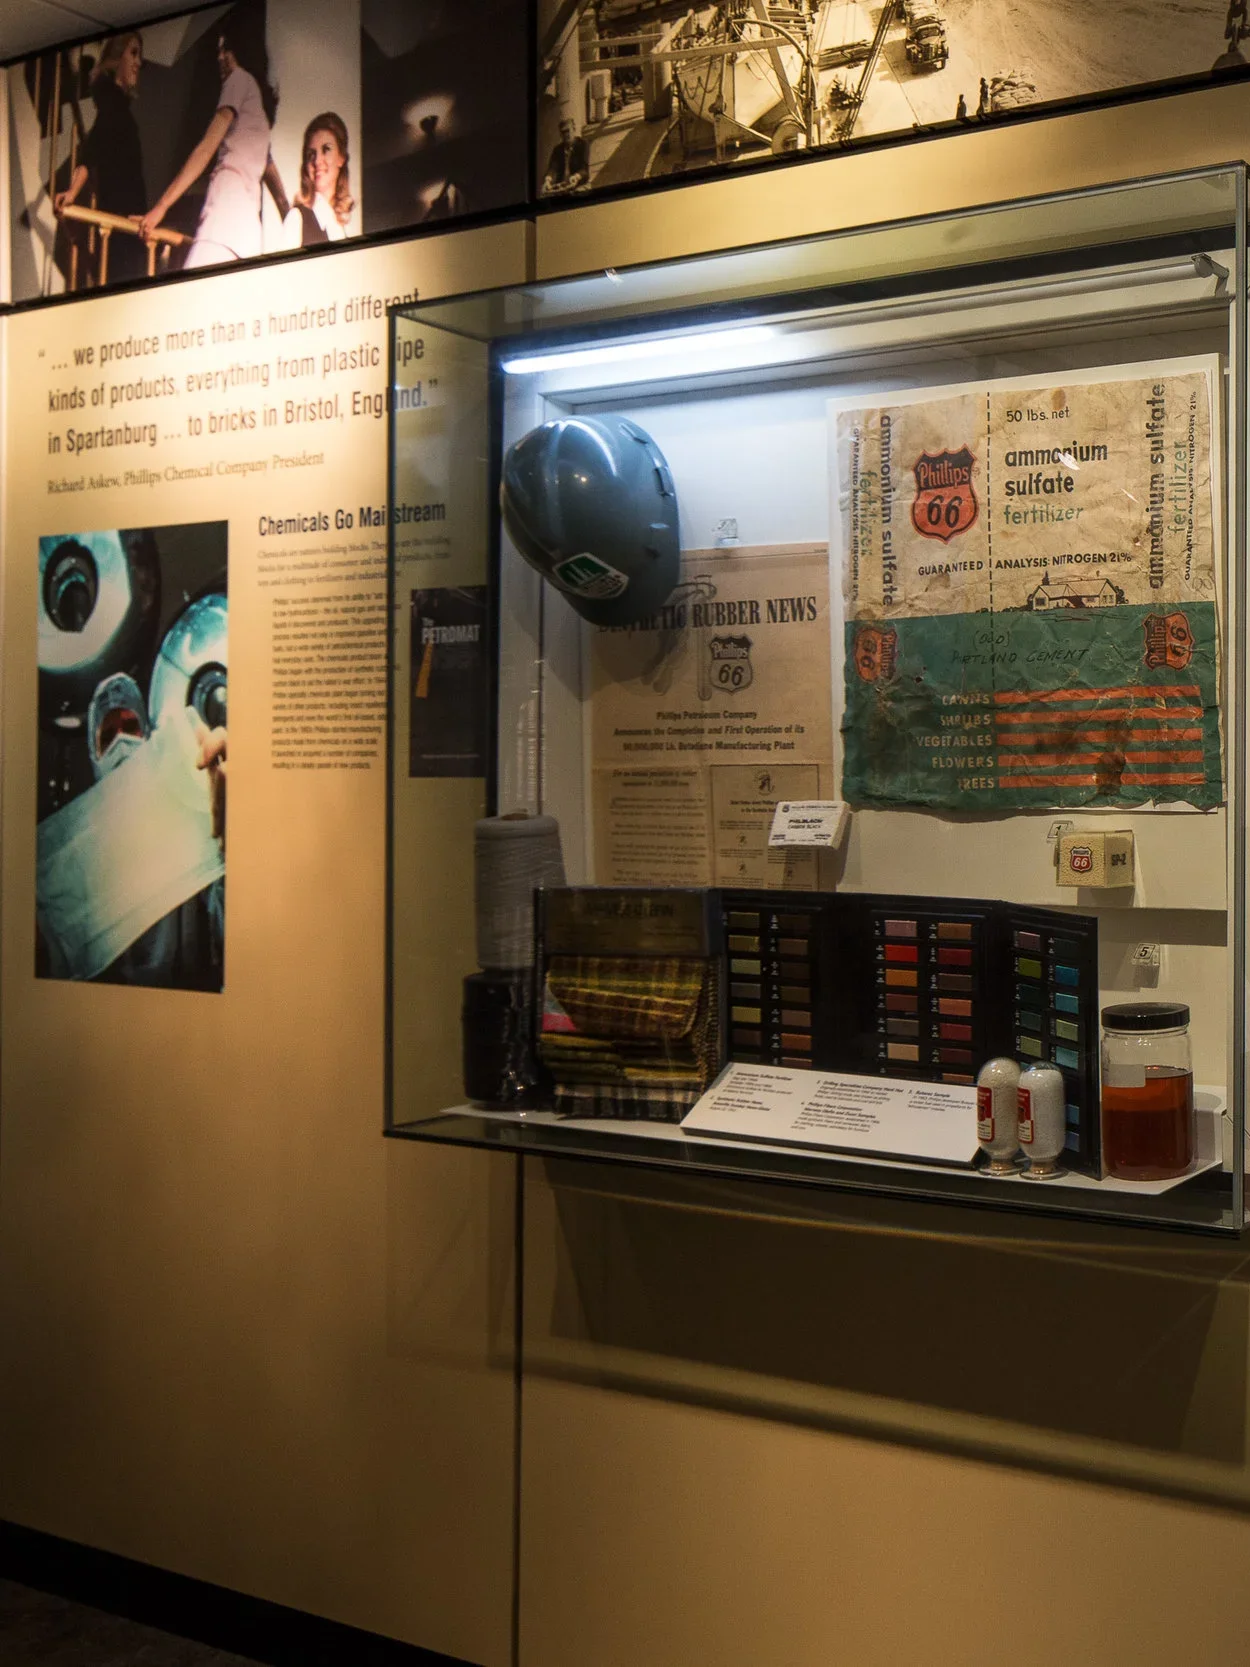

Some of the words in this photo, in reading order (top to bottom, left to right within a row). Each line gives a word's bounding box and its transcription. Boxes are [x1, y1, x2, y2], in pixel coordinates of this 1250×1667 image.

[73, 346, 95, 367] we
[100, 335, 160, 368] produce
[166, 328, 205, 352] more
[211, 320, 246, 345] than
[252, 319, 262, 338] a
[268, 301, 336, 334] hundred
[48, 382, 86, 412] kinds
[91, 382, 105, 406] of
[110, 376, 180, 409] products,
[186, 362, 270, 393] everything
[277, 354, 315, 379] from
[323, 342, 380, 379] plastic
[396, 336, 425, 367] ipe
[48, 432, 61, 454] in
[66, 421, 158, 456] Spartanburg
[188, 415, 202, 437] to
[209, 406, 256, 435] bricks
[263, 402, 277, 426] in
[285, 393, 344, 425] Bristol,
[1007, 410, 1022, 422] 50
[1027, 409, 1048, 421] lbs.
[1052, 407, 1069, 419] net
[1146, 384, 1166, 465] sulfate
[1005, 440, 1108, 466] ammonium
[48, 477, 85, 495] Richard
[124, 468, 162, 488] Phillips
[164, 462, 213, 482] Chemical
[216, 457, 269, 478] Company
[272, 450, 325, 470] President
[880, 415, 896, 524] ammonium
[918, 460, 969, 489] Phillips
[1005, 471, 1074, 496] sulfate
[1167, 441, 1187, 534] fertilizer
[258, 511, 330, 537] Chemicals
[335, 508, 354, 530] Go
[359, 502, 446, 528] Maistream
[927, 495, 963, 528] 66
[1004, 504, 1083, 524] fertilizer
[1146, 473, 1165, 590] ammonium
[1185, 518, 1193, 581] GUARANTEED
[882, 530, 897, 606] sulfate
[918, 560, 984, 576] GUARANTEED
[995, 557, 1050, 569] ANALYSIS:
[1052, 553, 1107, 566] NITROGEN
[1109, 552, 1132, 562] 21%
[692, 600, 761, 628] RUBBER
[766, 596, 817, 624] NEWS
[421, 624, 481, 645] PETROMAT
[1149, 618, 1165, 666] Phillips
[1026, 649, 1090, 664] CEMENT
[719, 664, 745, 686] 66
[723, 710, 757, 721] Company
[940, 714, 991, 726] SHRUBS
[708, 726, 722, 734] and
[725, 725, 743, 734] First
[745, 725, 782, 735] Operation
[784, 725, 793, 734] of
[795, 725, 805, 734] its
[916, 735, 992, 747] VEGETABLES
[715, 741, 772, 751] Manufacturing
[774, 741, 795, 750] Plant
[932, 756, 994, 768] FLOWERS
[1074, 857, 1088, 867] 66
[1140, 947, 1149, 957] 5
